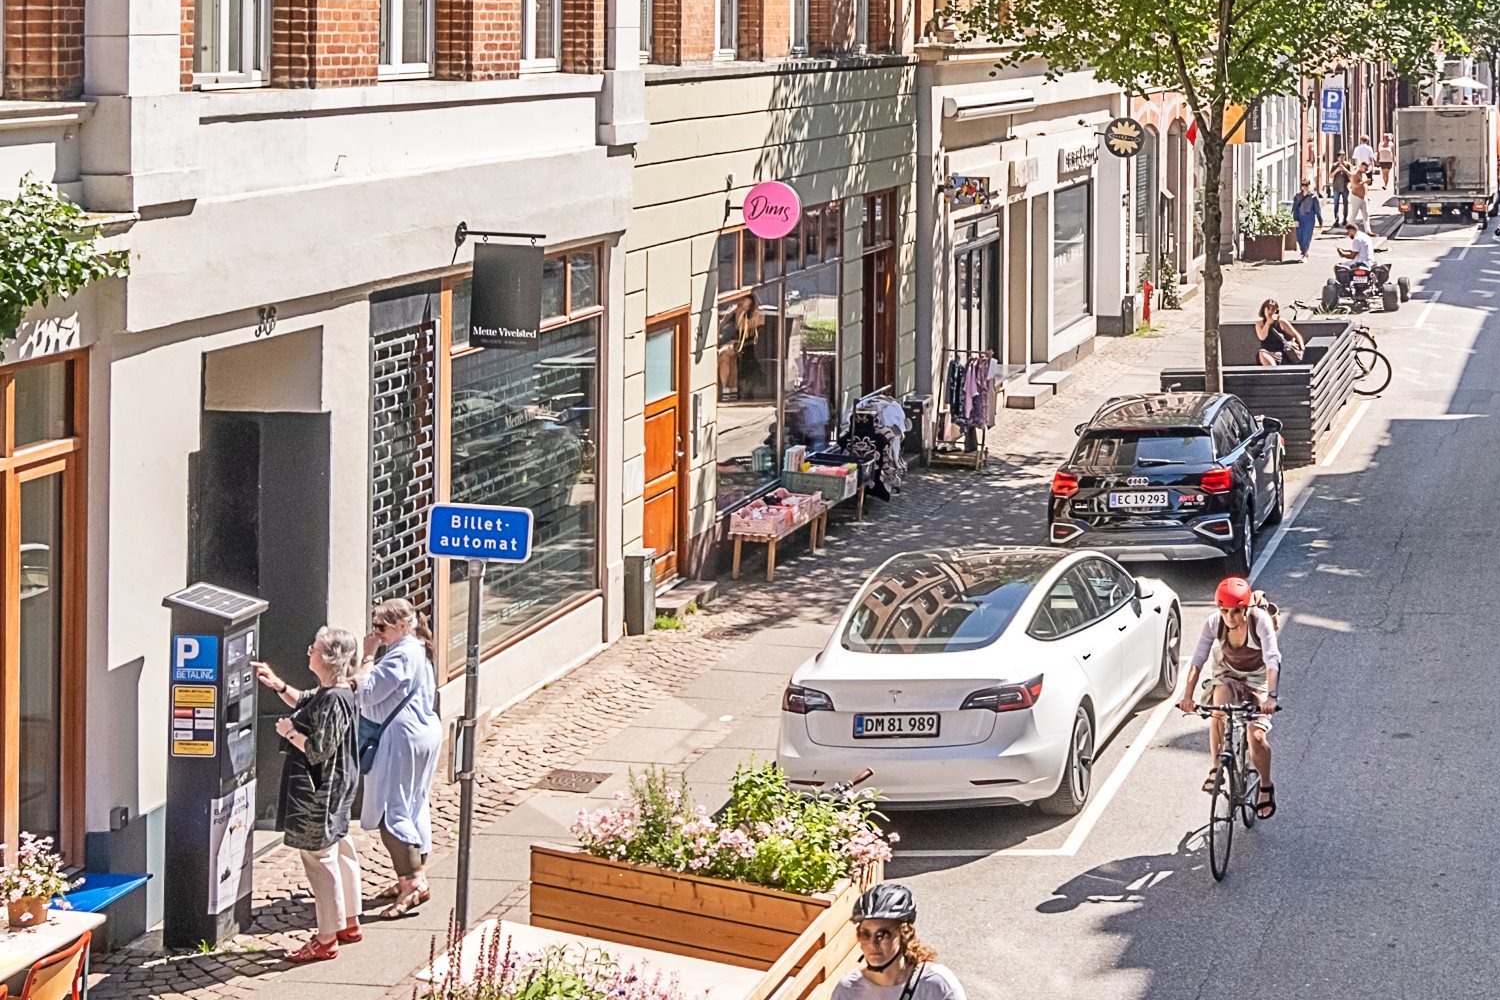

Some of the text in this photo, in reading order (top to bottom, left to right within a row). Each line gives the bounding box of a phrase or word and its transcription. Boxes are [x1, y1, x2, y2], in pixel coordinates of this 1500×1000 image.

[1327, 91, 1339, 108] P
[748, 195, 791, 222] Dims
[255, 305, 277, 337] 36
[473, 326, 537, 338] Mette Vivelsted
[1118, 495, 1166, 504] EC 19 293
[440, 535, 517, 551] automat
[176, 637, 200, 668] P
[176, 669, 214, 680] BETALING
[865, 717, 935, 732] DM 81 989
